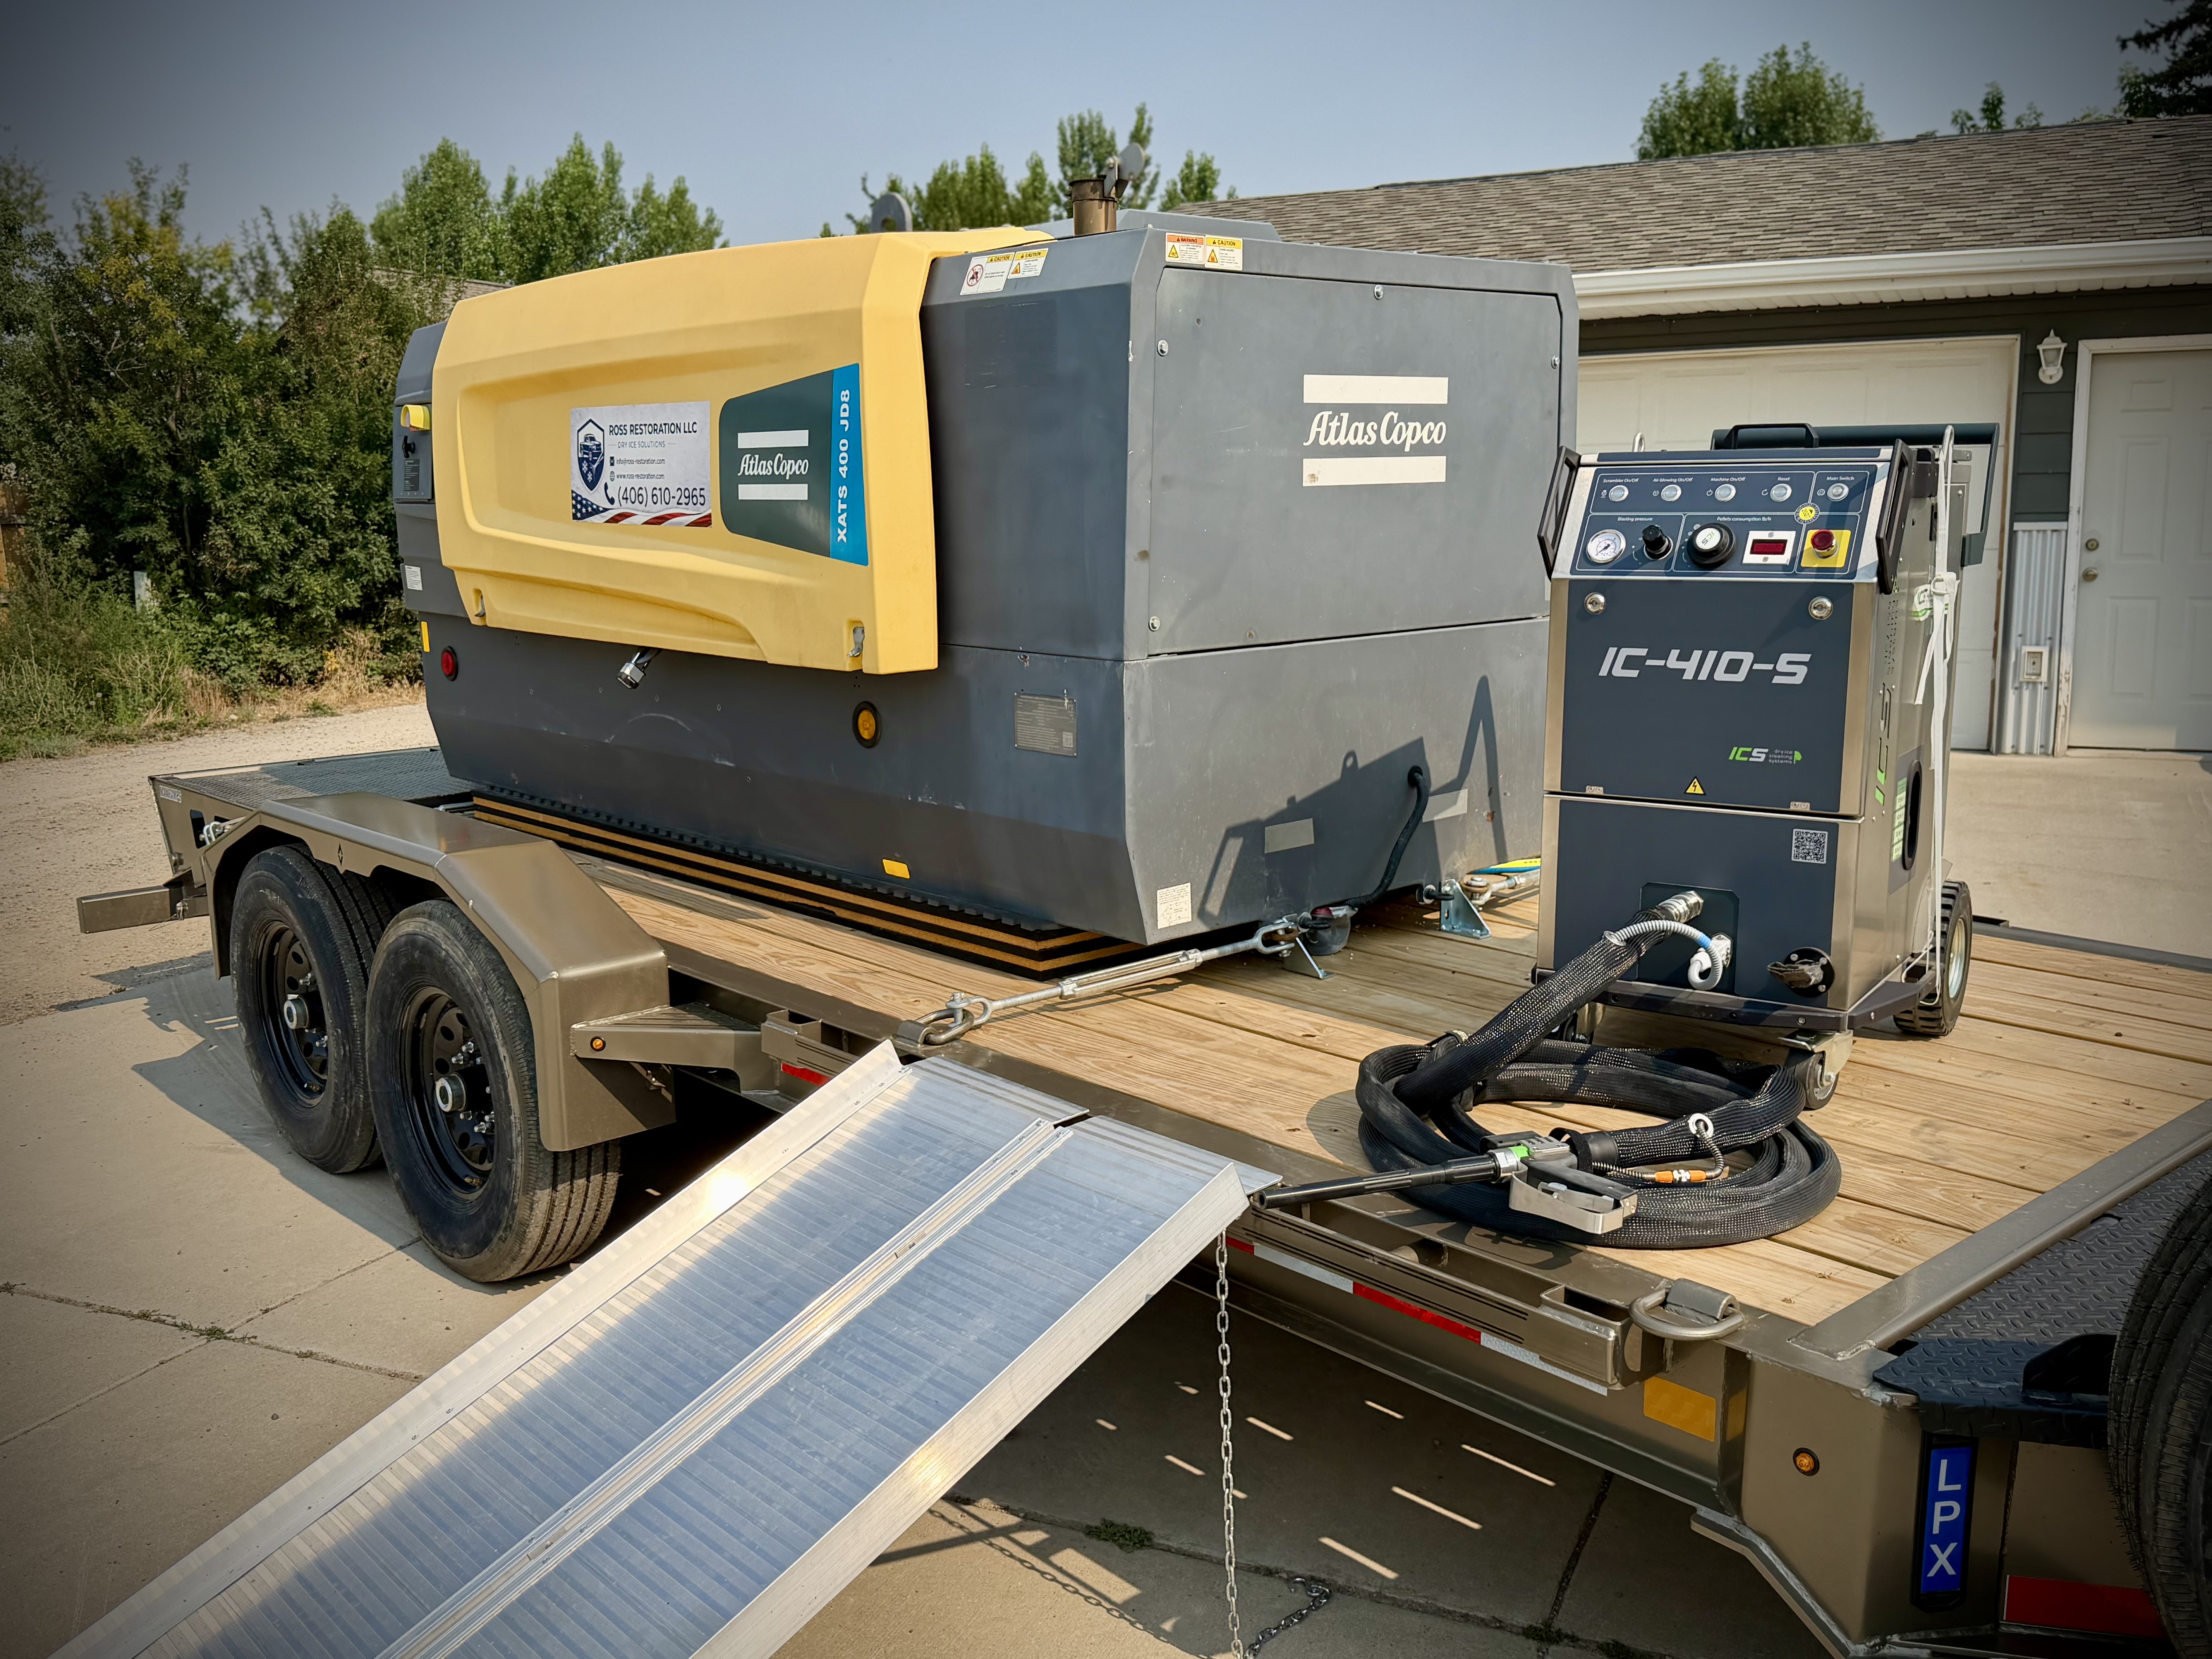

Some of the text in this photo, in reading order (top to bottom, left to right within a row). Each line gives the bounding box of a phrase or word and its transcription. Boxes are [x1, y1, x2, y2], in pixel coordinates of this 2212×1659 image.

[609, 422, 697, 436] ROSS RESTORATION LLC
[1303, 410, 1446, 452] Atlas Copco
[738, 453, 809, 480] Atlas Copco
[837, 390, 850, 543] XATS 400 JD8
[618, 486, 706, 507] (406) 610-2965
[1598, 647, 1812, 684] IC-410-S
[1729, 747, 1769, 762] ICS
[1927, 1459, 1961, 1577] LPX
